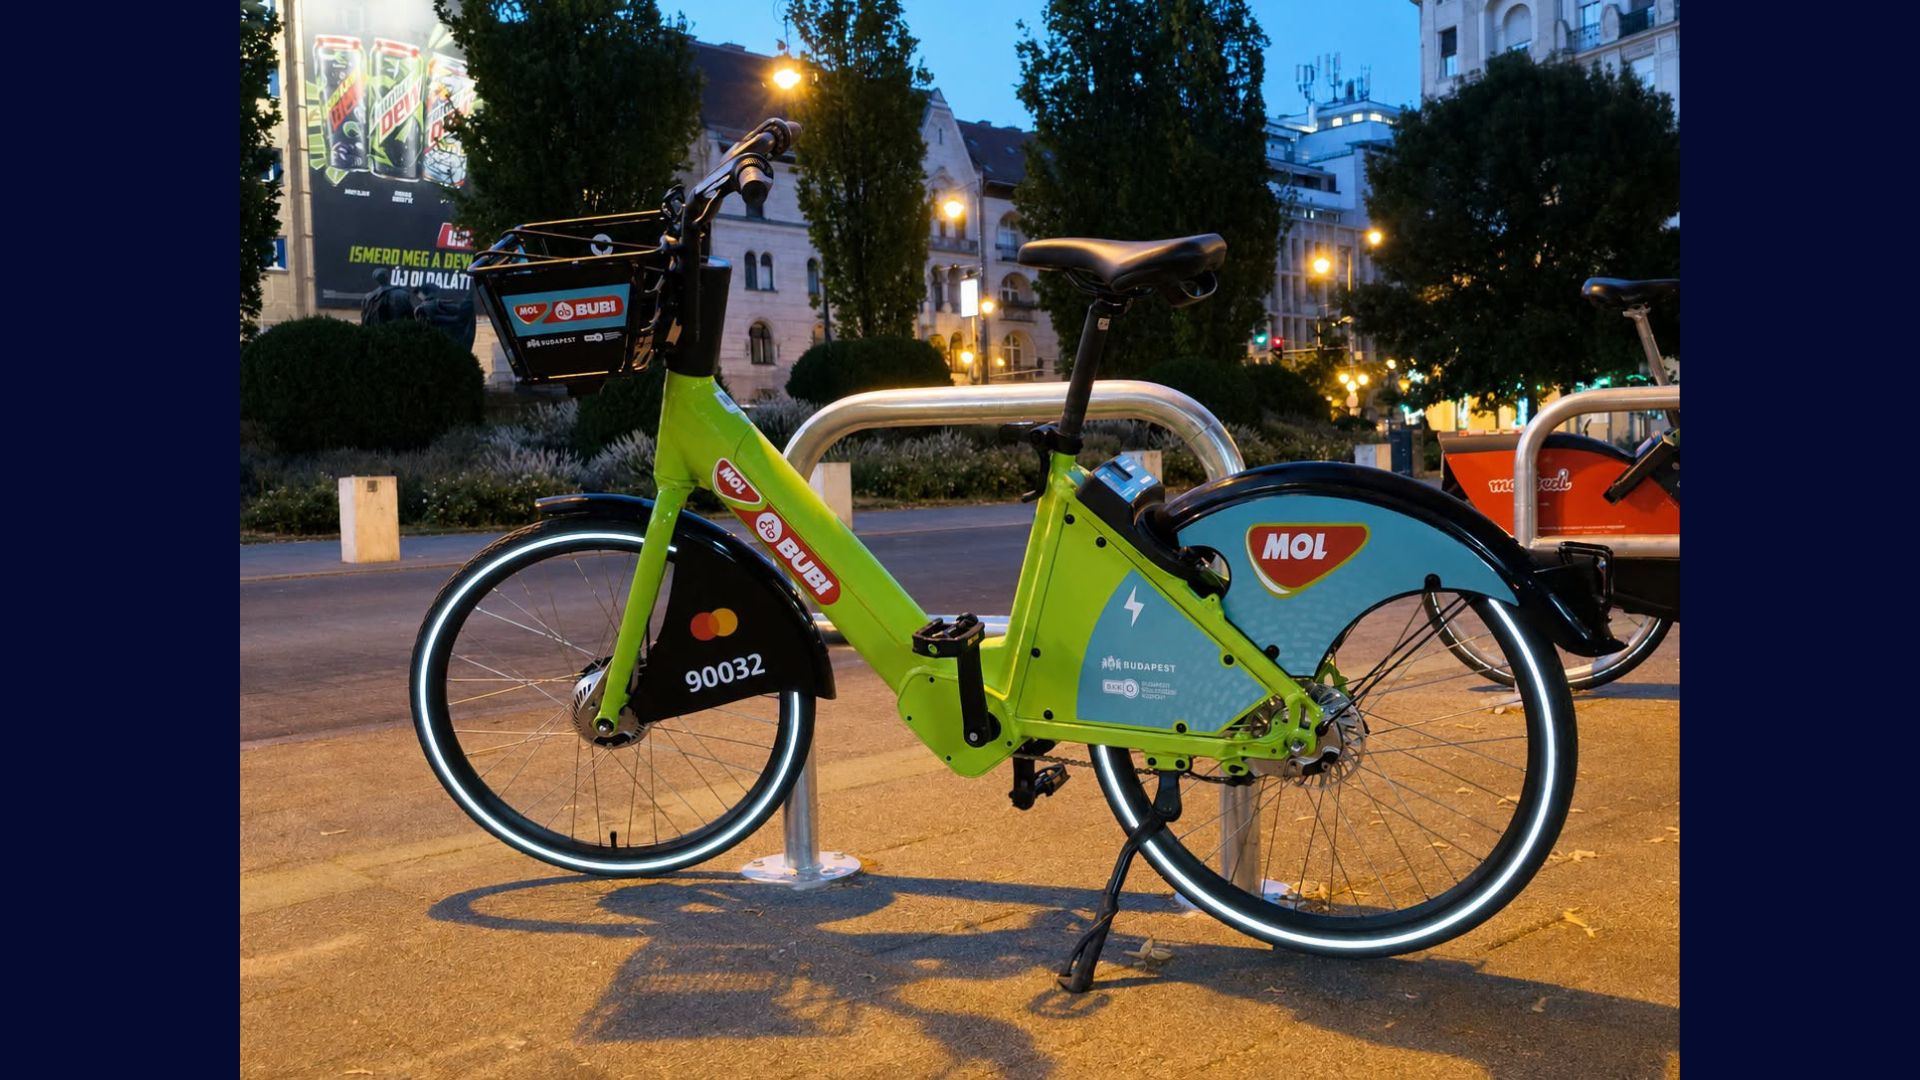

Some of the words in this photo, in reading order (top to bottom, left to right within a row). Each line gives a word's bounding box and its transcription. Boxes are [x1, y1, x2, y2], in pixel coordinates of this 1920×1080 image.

[349, 245, 400, 265] ISMERD
[402, 249, 430, 268] MEG
[431, 251, 441, 268] A
[519, 306, 538, 315] MOL
[576, 299, 616, 316] BUBI
[719, 466, 745, 495] MOL
[1262, 532, 1328, 560] MOL
[776, 536, 833, 596] BUBI
[685, 653, 765, 693] 90032
[1123, 660, 1176, 673] BUDAPEST
